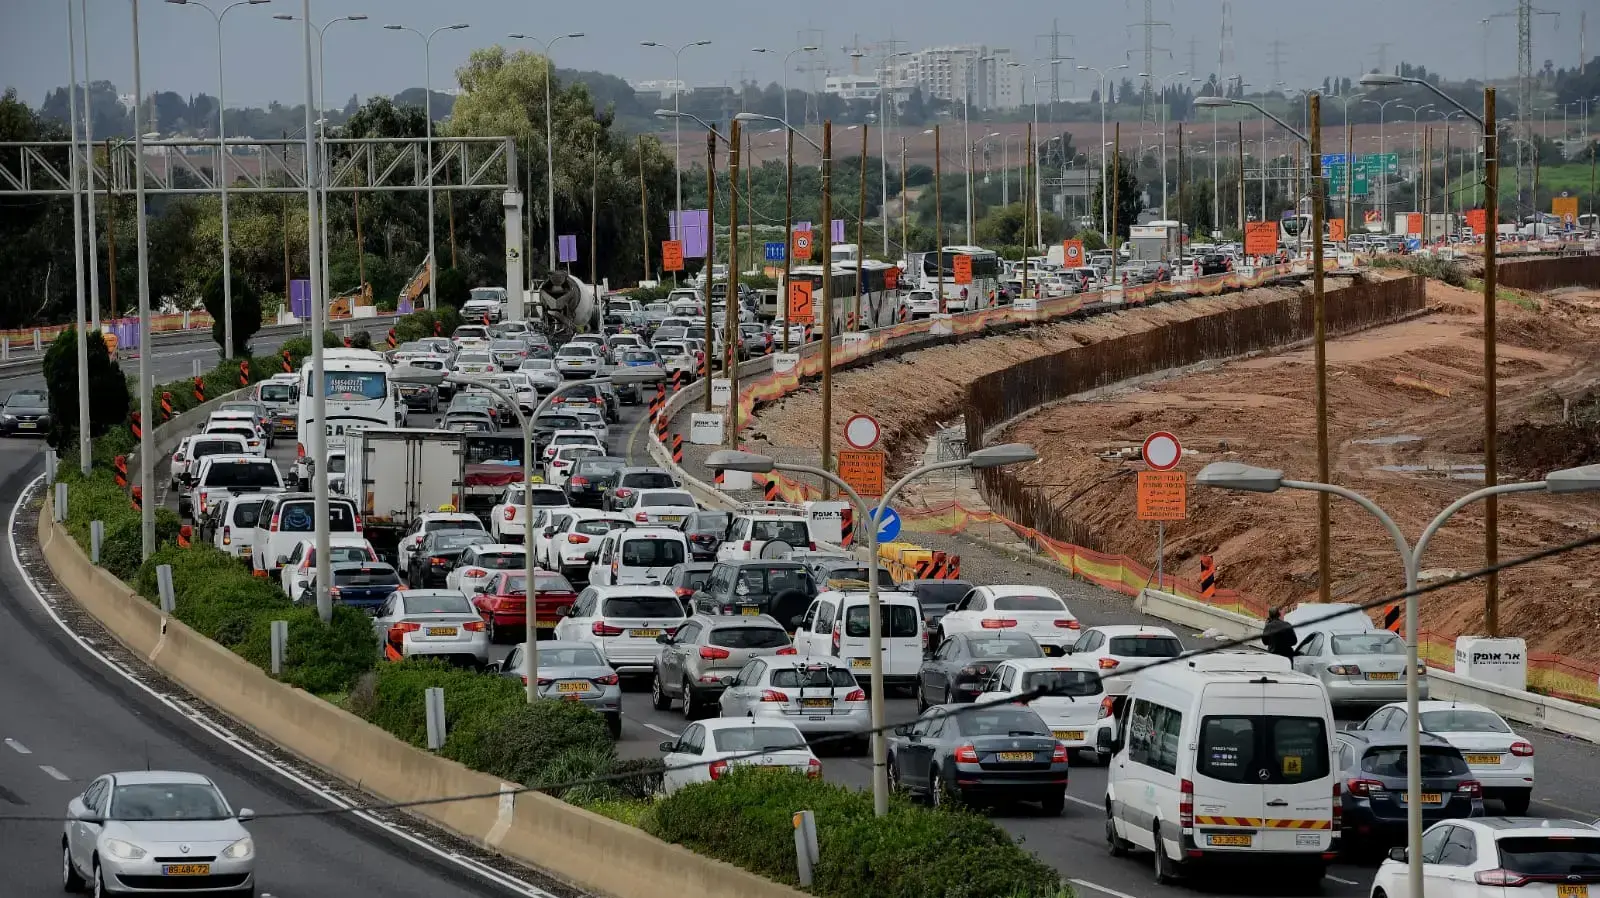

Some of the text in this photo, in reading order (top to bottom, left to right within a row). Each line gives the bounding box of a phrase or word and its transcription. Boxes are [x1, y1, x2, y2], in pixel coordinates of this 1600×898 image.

[812, 511, 833, 520] אופק
[1473, 652, 1502, 662] אופק
[1504, 652, 1521, 660] אר
